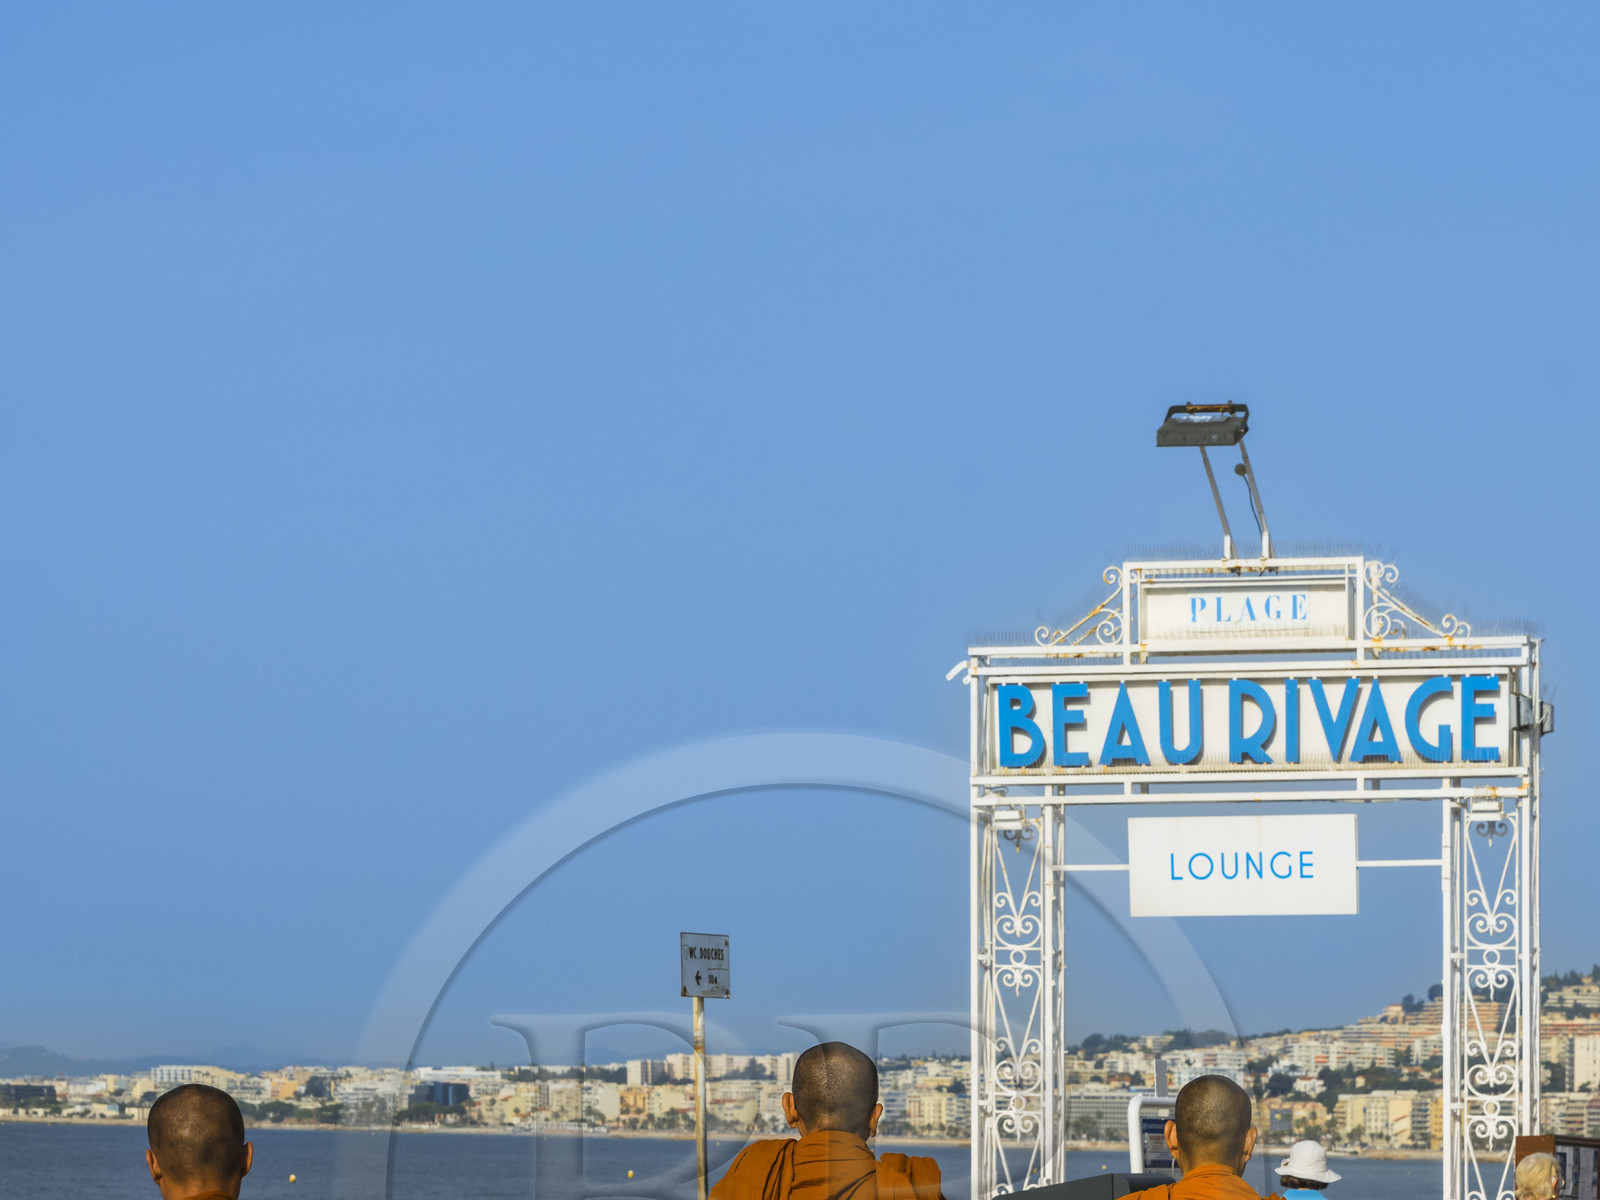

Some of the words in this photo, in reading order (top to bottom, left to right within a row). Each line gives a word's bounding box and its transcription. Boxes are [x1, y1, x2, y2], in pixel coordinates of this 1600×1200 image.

[1189, 593, 1307, 623] PLAGE
[997, 679, 1202, 768] BEAU
[1227, 675, 1501, 765] RIVAGE
[1169, 850, 1315, 881] LOUNGE
[700, 947, 724, 960] DOUCHES
